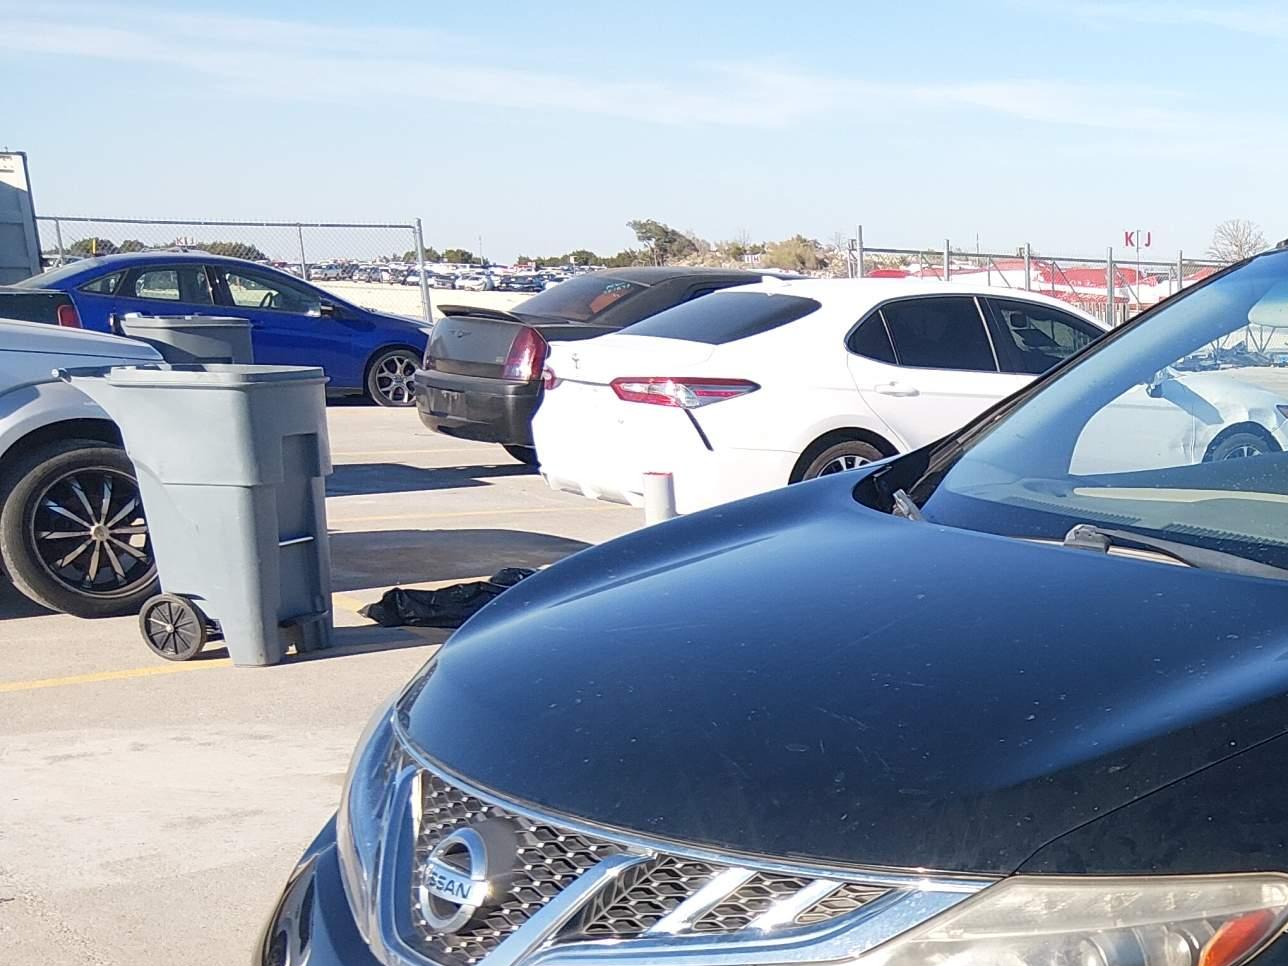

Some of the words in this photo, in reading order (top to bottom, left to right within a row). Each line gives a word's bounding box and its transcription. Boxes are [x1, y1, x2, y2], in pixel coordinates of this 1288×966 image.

[1125, 231, 1136, 247] K
[1144, 231, 1152, 248] J
[424, 868, 472, 898] SSAN
